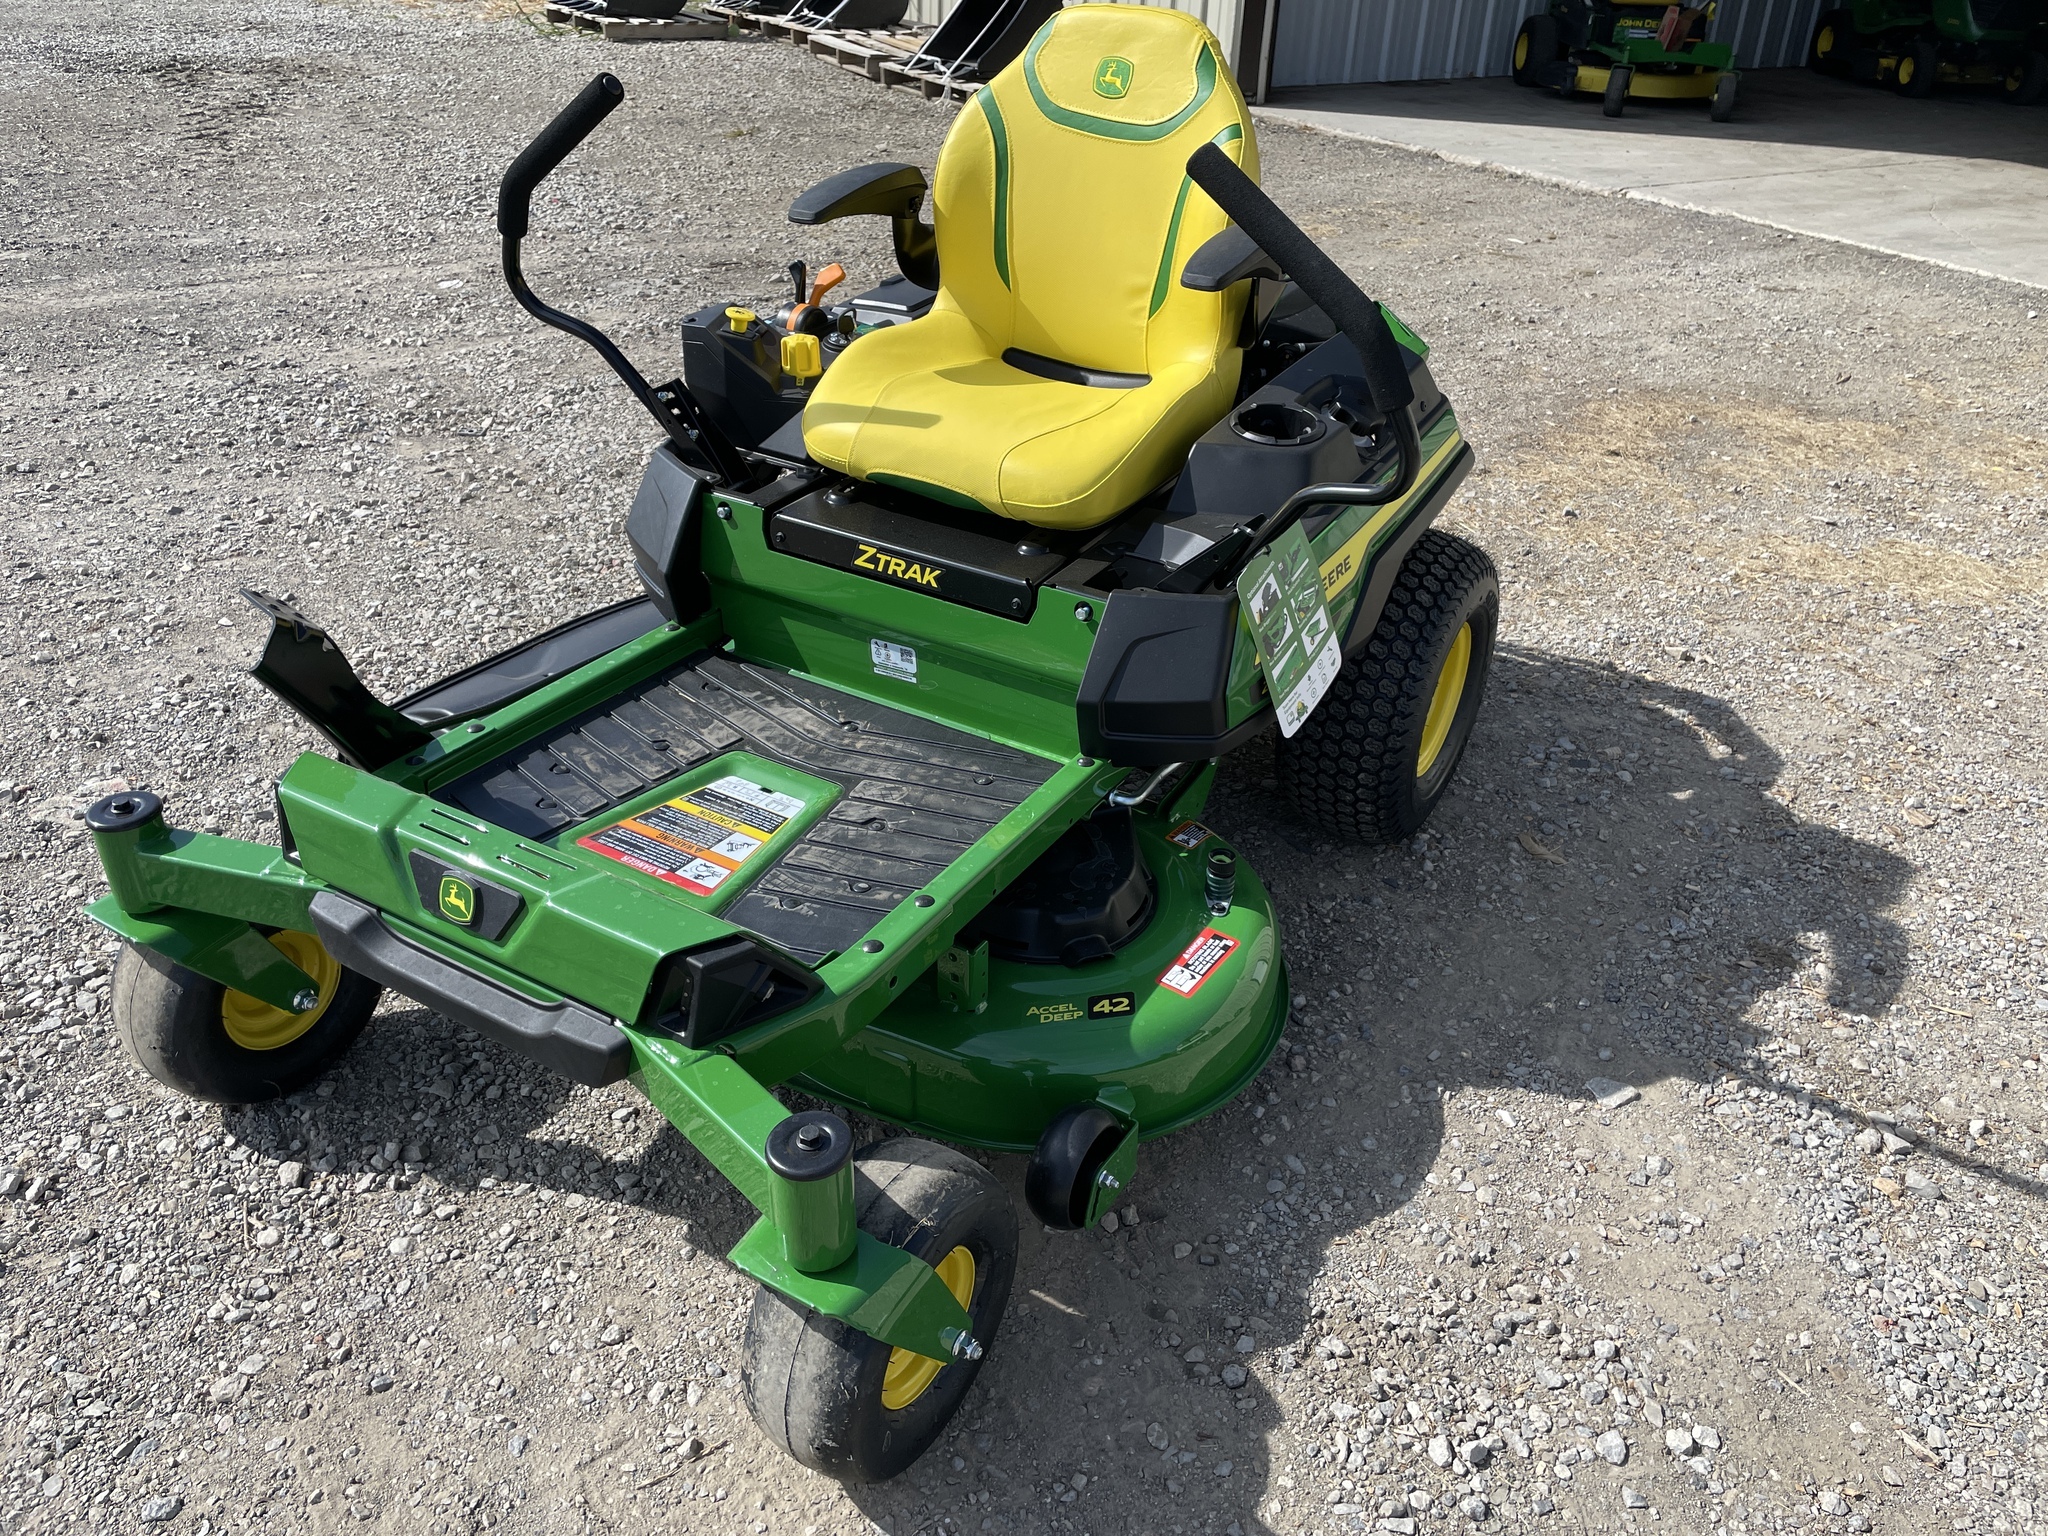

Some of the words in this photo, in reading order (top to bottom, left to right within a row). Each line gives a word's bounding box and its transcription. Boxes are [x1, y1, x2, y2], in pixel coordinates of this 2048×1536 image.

[1617, 18, 1643, 27] JOHN
[1645, 19, 1661, 28] DE
[854, 544, 941, 588] ZTRAK
[1321, 554, 1352, 591] EERE
[697, 809, 732, 825] CAUTION
[656, 832, 694, 850] WARNING
[620, 855, 656, 872] DANGER
[1186, 936, 1206, 955] DANGER
[1026, 1003, 1077, 1016] ACCEL
[1093, 997, 1130, 1013] 42
[1040, 1011, 1083, 1023] DEEP
